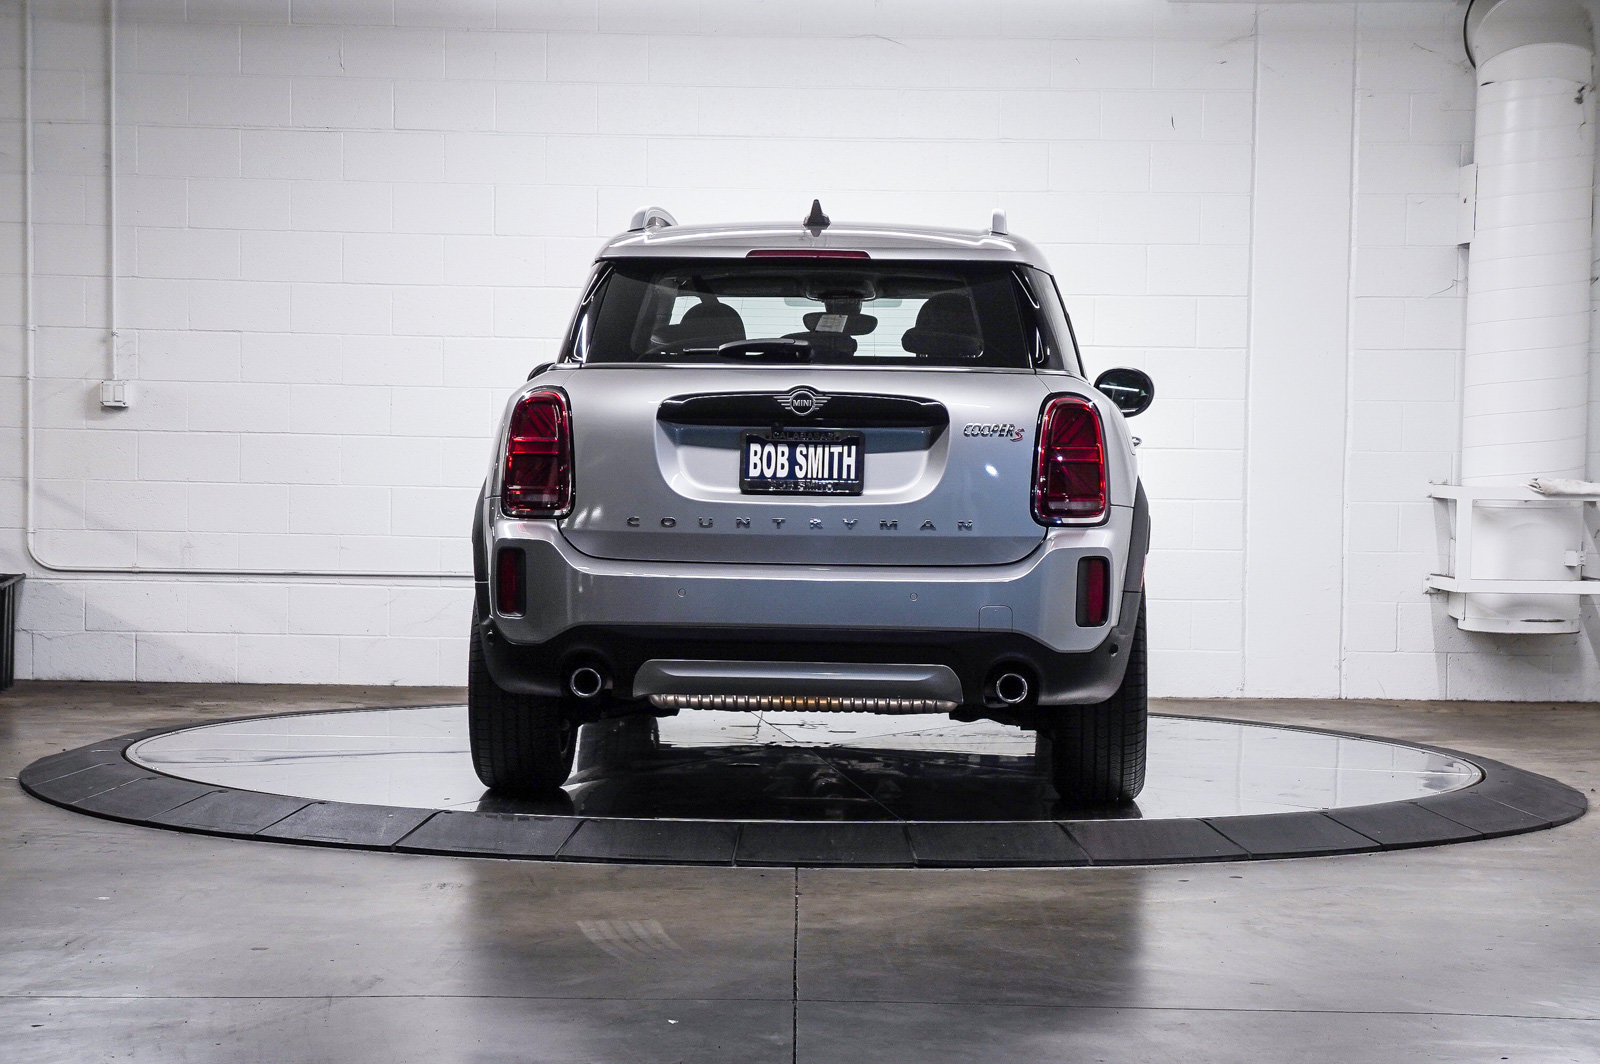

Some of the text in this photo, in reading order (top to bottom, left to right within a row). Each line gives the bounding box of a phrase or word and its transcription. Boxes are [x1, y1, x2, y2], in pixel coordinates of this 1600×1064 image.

[792, 399, 812, 407] MINI
[963, 423, 1015, 437] COOPER
[749, 443, 856, 479] BOB SMITH
[627, 516, 974, 531] COUNTRYMAN
